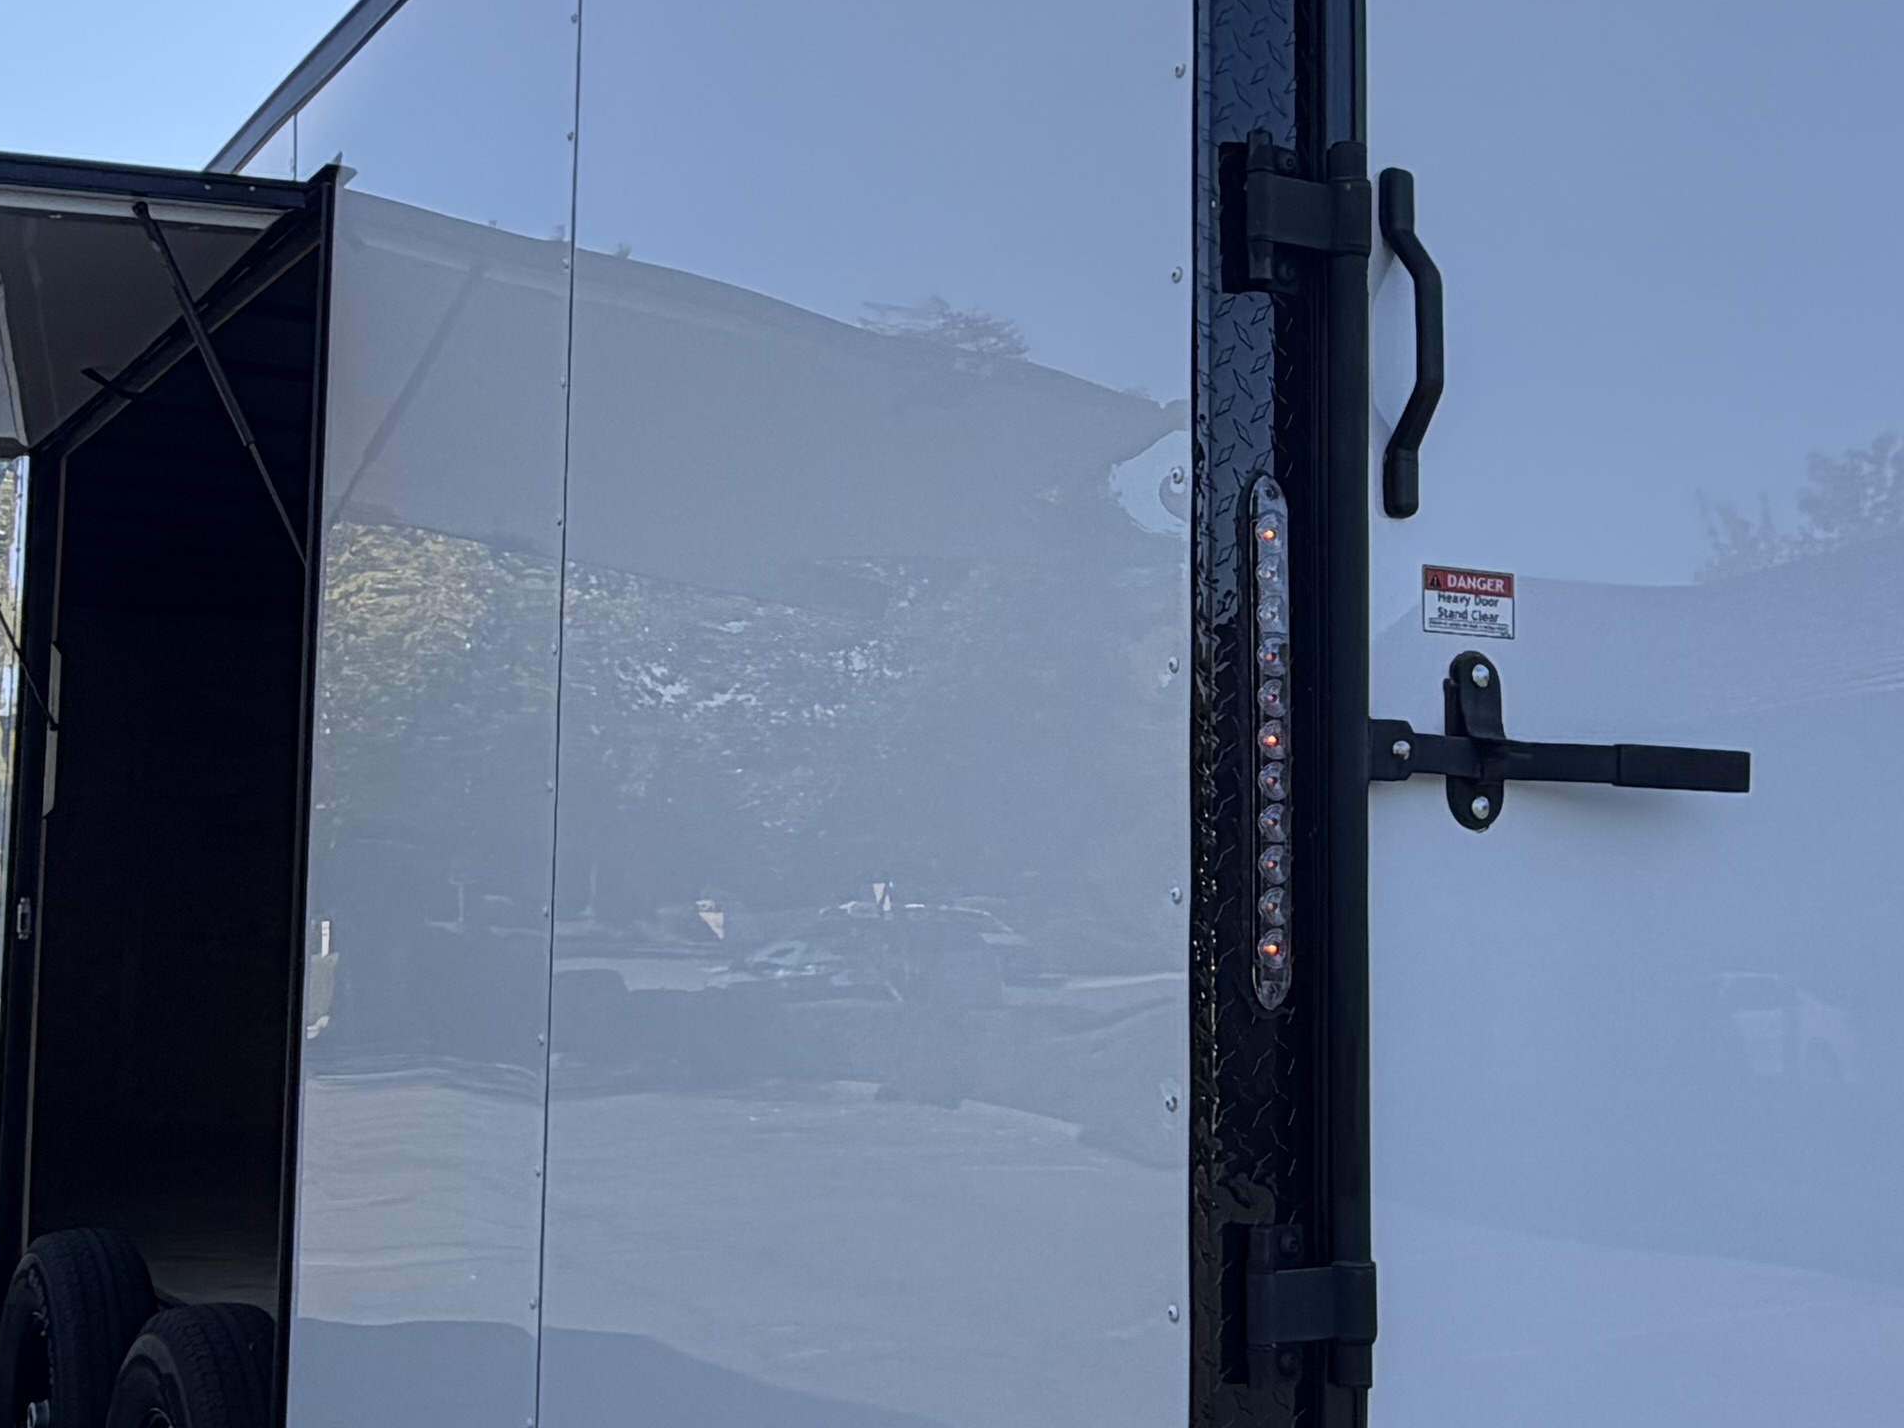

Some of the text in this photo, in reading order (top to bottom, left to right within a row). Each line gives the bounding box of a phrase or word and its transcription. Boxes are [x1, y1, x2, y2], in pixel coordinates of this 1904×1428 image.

[1447, 573, 1504, 592] DANGER
[1437, 592, 1499, 608] Heavy Door
[1437, 606, 1499, 623] Stand Clear
